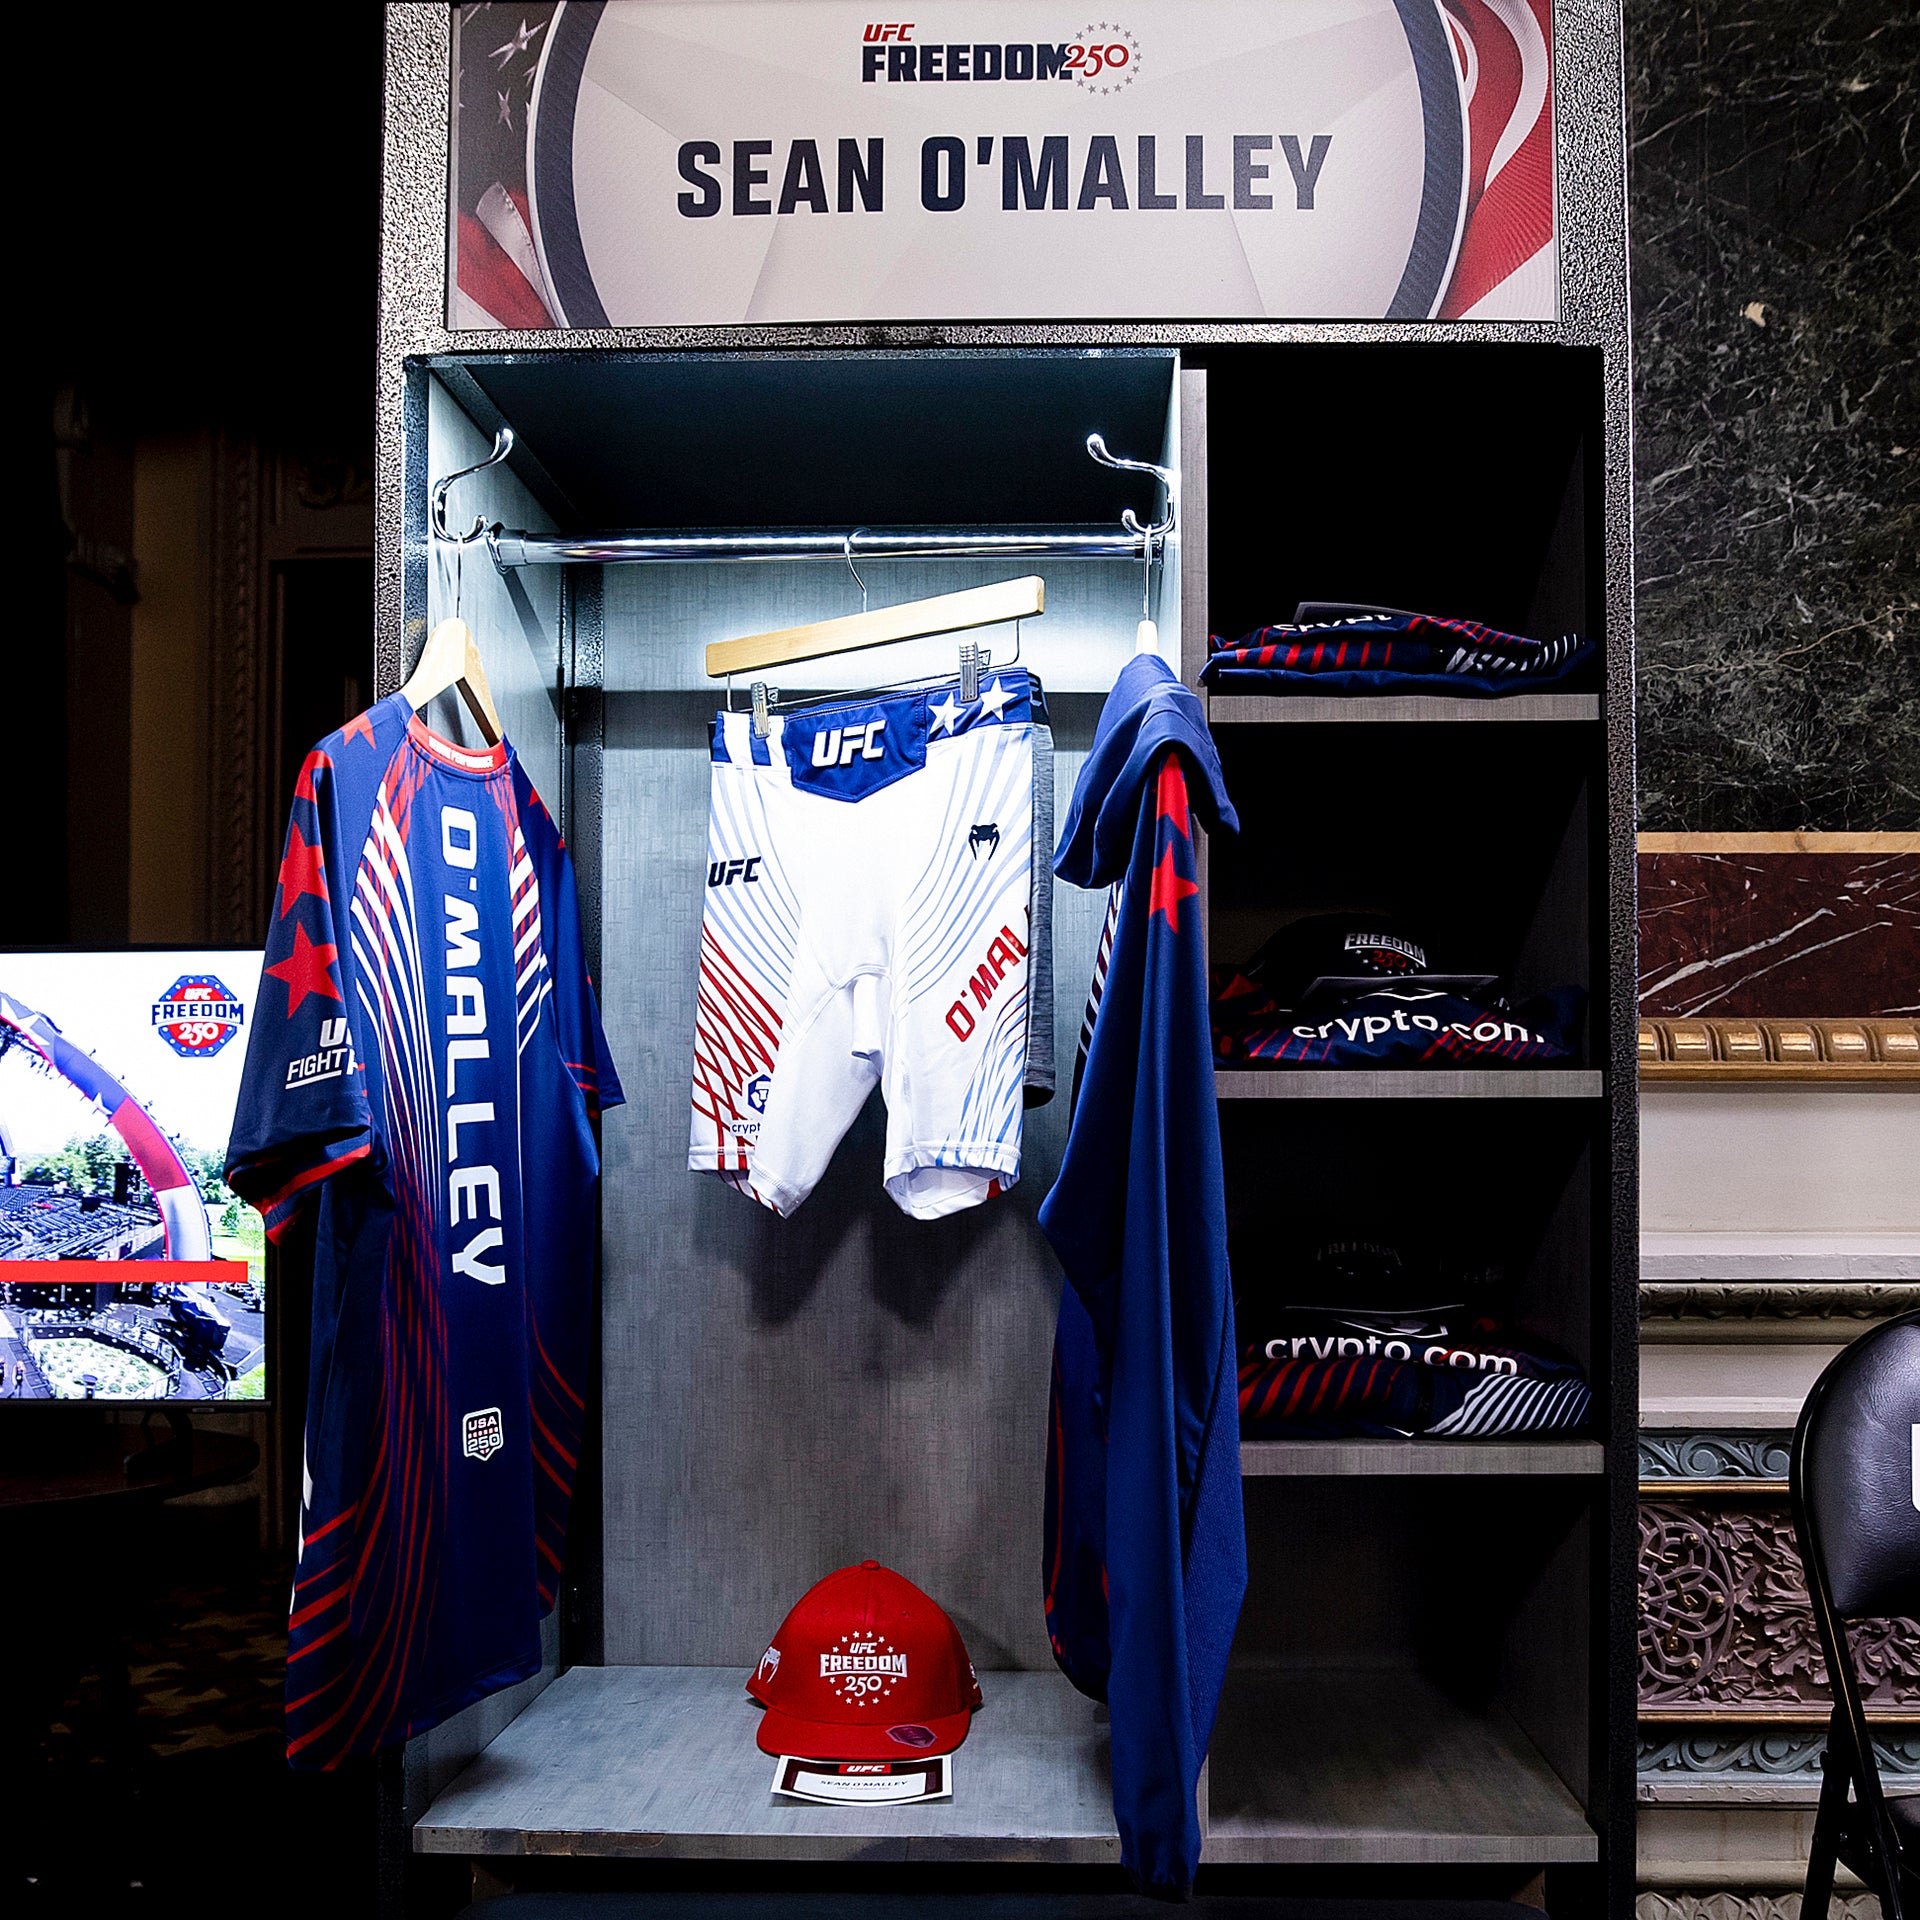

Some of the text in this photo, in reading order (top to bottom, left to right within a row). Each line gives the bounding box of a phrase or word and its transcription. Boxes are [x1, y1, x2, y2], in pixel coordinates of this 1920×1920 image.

[863, 24, 915, 42] UFC
[862, 43, 1129, 83] FREEDOM 250
[677, 135, 1333, 218] SEAN O'MALLEY
[811, 720, 887, 768] UFC
[708, 856, 762, 888] UFC
[1344, 933, 1427, 968] FREEDOM
[1373, 950, 1407, 968] 250
[945, 904, 1030, 1042] O'MAL
[184, 987, 213, 1001] UFC
[151, 1003, 244, 1026] FREEDOM
[178, 1022, 219, 1046] 250
[440, 805, 506, 1286] O'MALLEY
[286, 1047, 349, 1082] FIGHT
[468, 1415, 498, 1432] USA
[467, 1433, 501, 1453] 250
[849, 1642, 878, 1654] UFC
[820, 1653, 908, 1678] FREEDOM
[844, 1675, 882, 1697] 250
[846, 1765, 886, 1773] UFC
